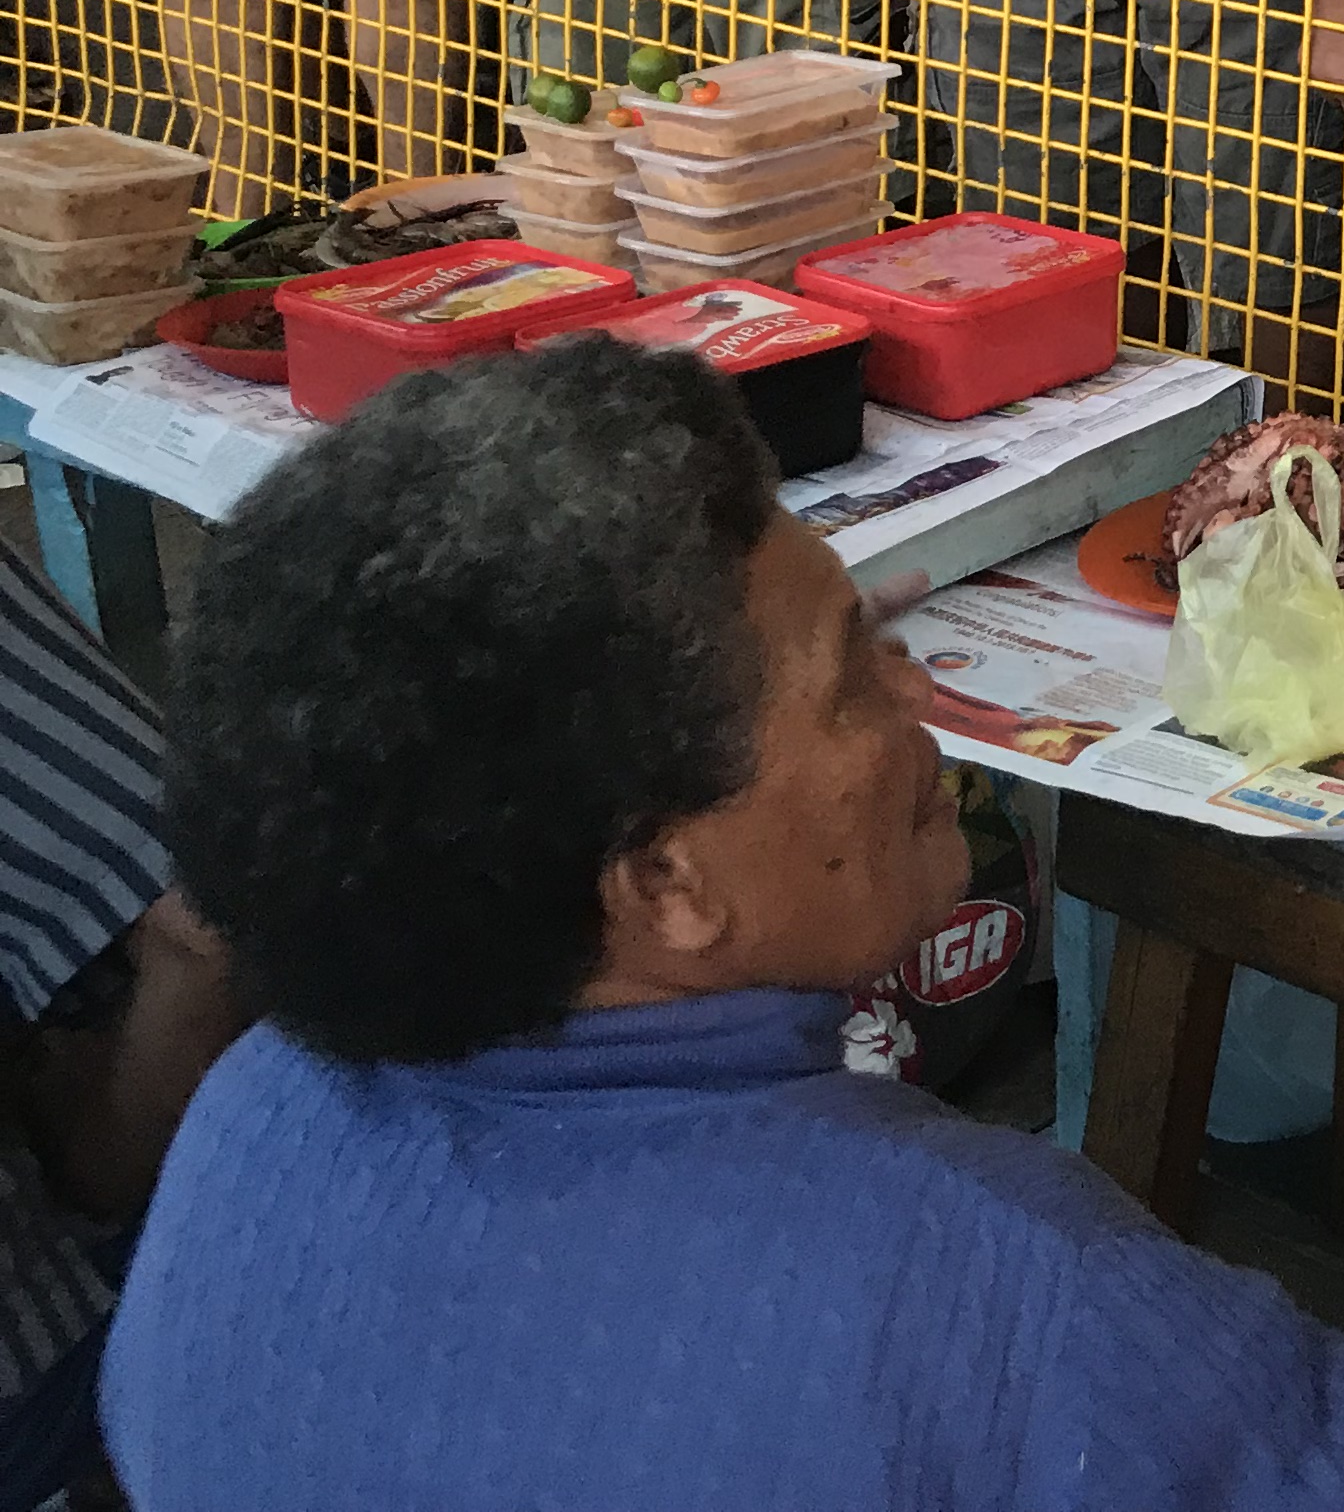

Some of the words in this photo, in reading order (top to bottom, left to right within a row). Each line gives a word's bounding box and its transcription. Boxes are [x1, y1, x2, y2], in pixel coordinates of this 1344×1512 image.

[344, 257, 506, 312] Passionfruit
[704, 314, 811, 359] Strawb
[920, 909, 1007, 996] IGA
